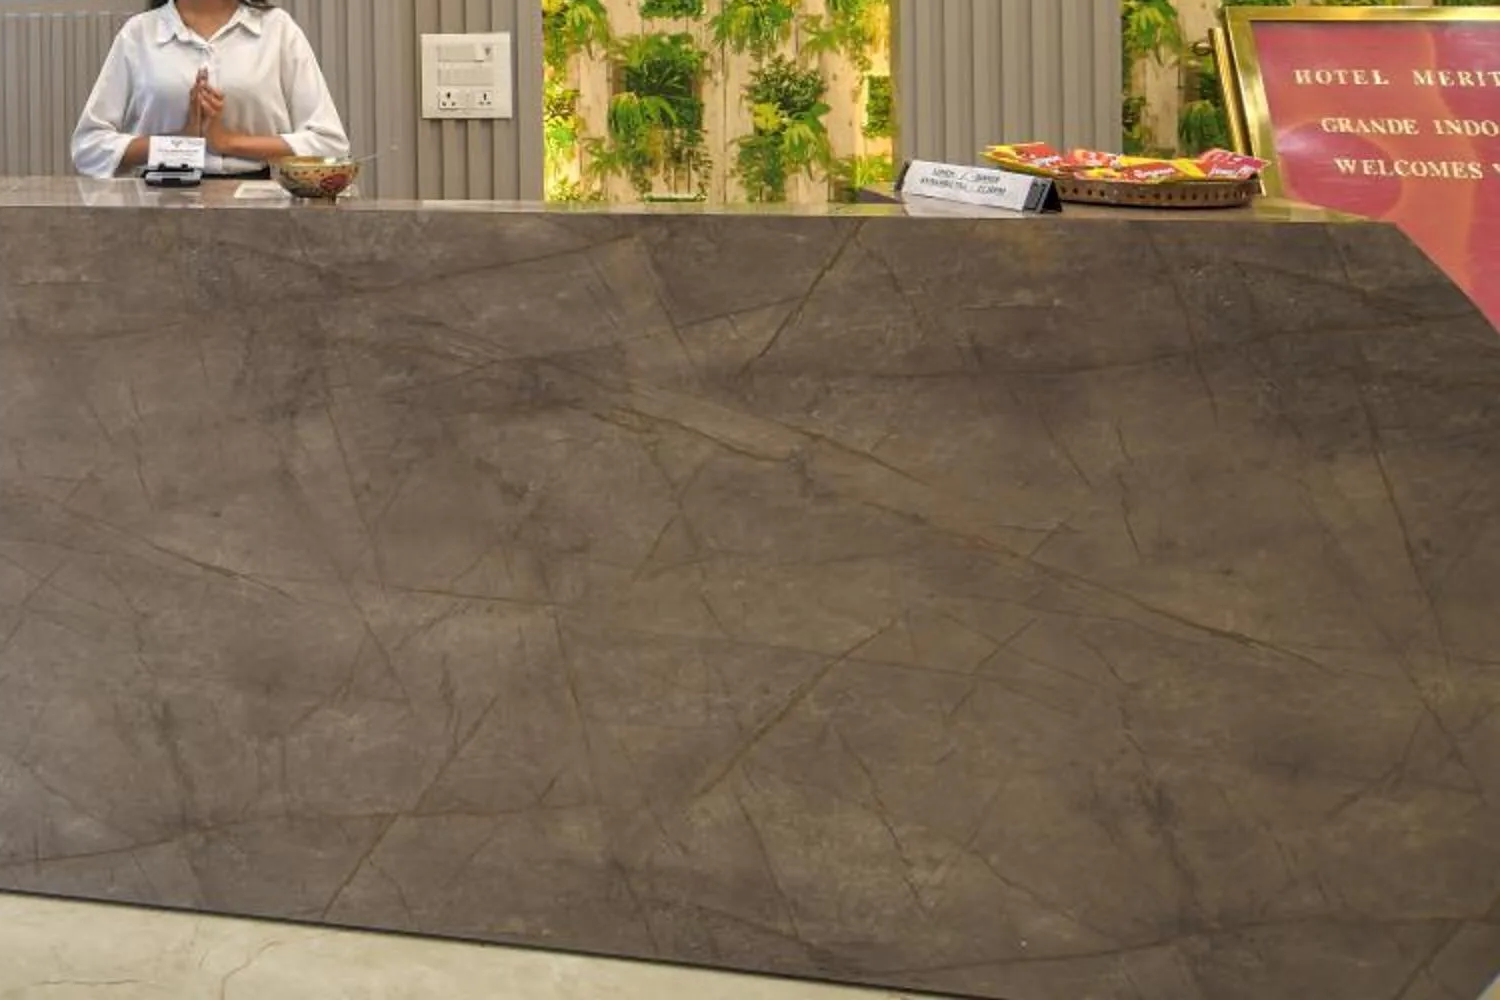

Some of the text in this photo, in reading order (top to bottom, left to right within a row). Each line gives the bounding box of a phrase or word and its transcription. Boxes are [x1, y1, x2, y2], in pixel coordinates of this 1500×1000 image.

[1293, 68, 1390, 86] HOTEL
[1320, 116, 1500, 137] GRANDE INDO
[1332, 156, 1484, 180] WELCOMES
